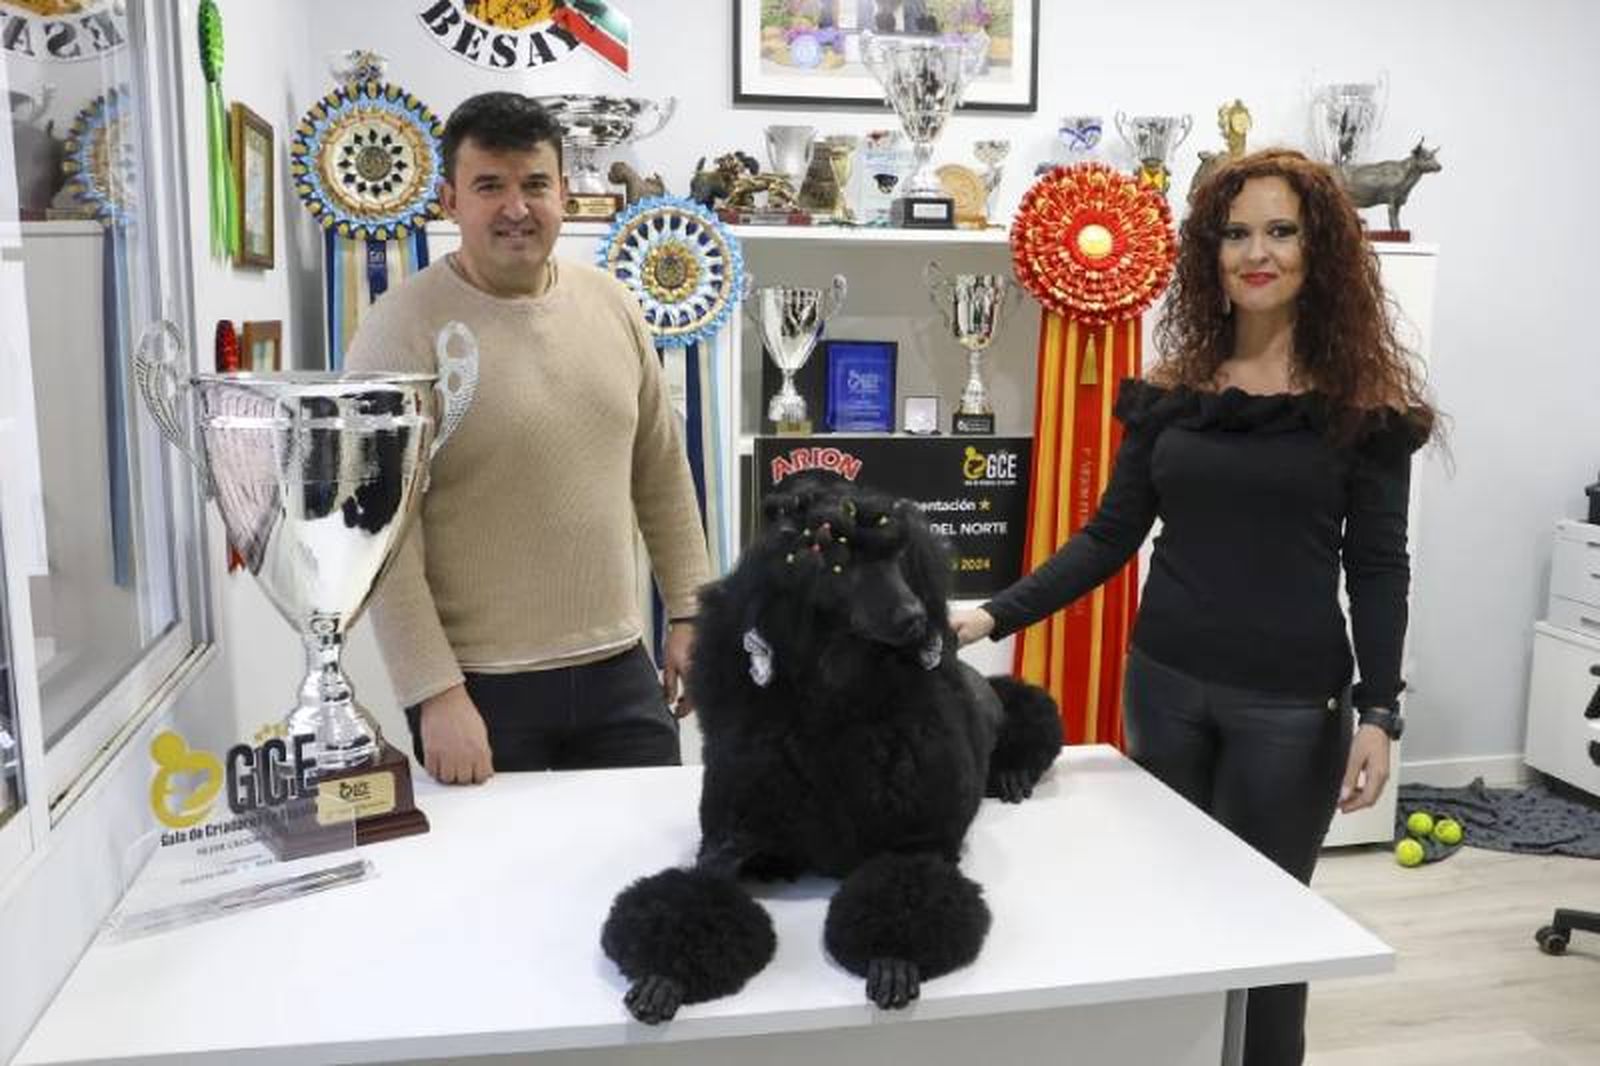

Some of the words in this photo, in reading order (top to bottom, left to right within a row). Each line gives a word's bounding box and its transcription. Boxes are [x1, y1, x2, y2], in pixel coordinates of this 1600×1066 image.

[771, 447, 863, 484] ARION
[986, 453, 1018, 479] GCE
[929, 523, 958, 536] DEL
[960, 521, 1009, 536] NORTE
[226, 733, 319, 815] GCE
